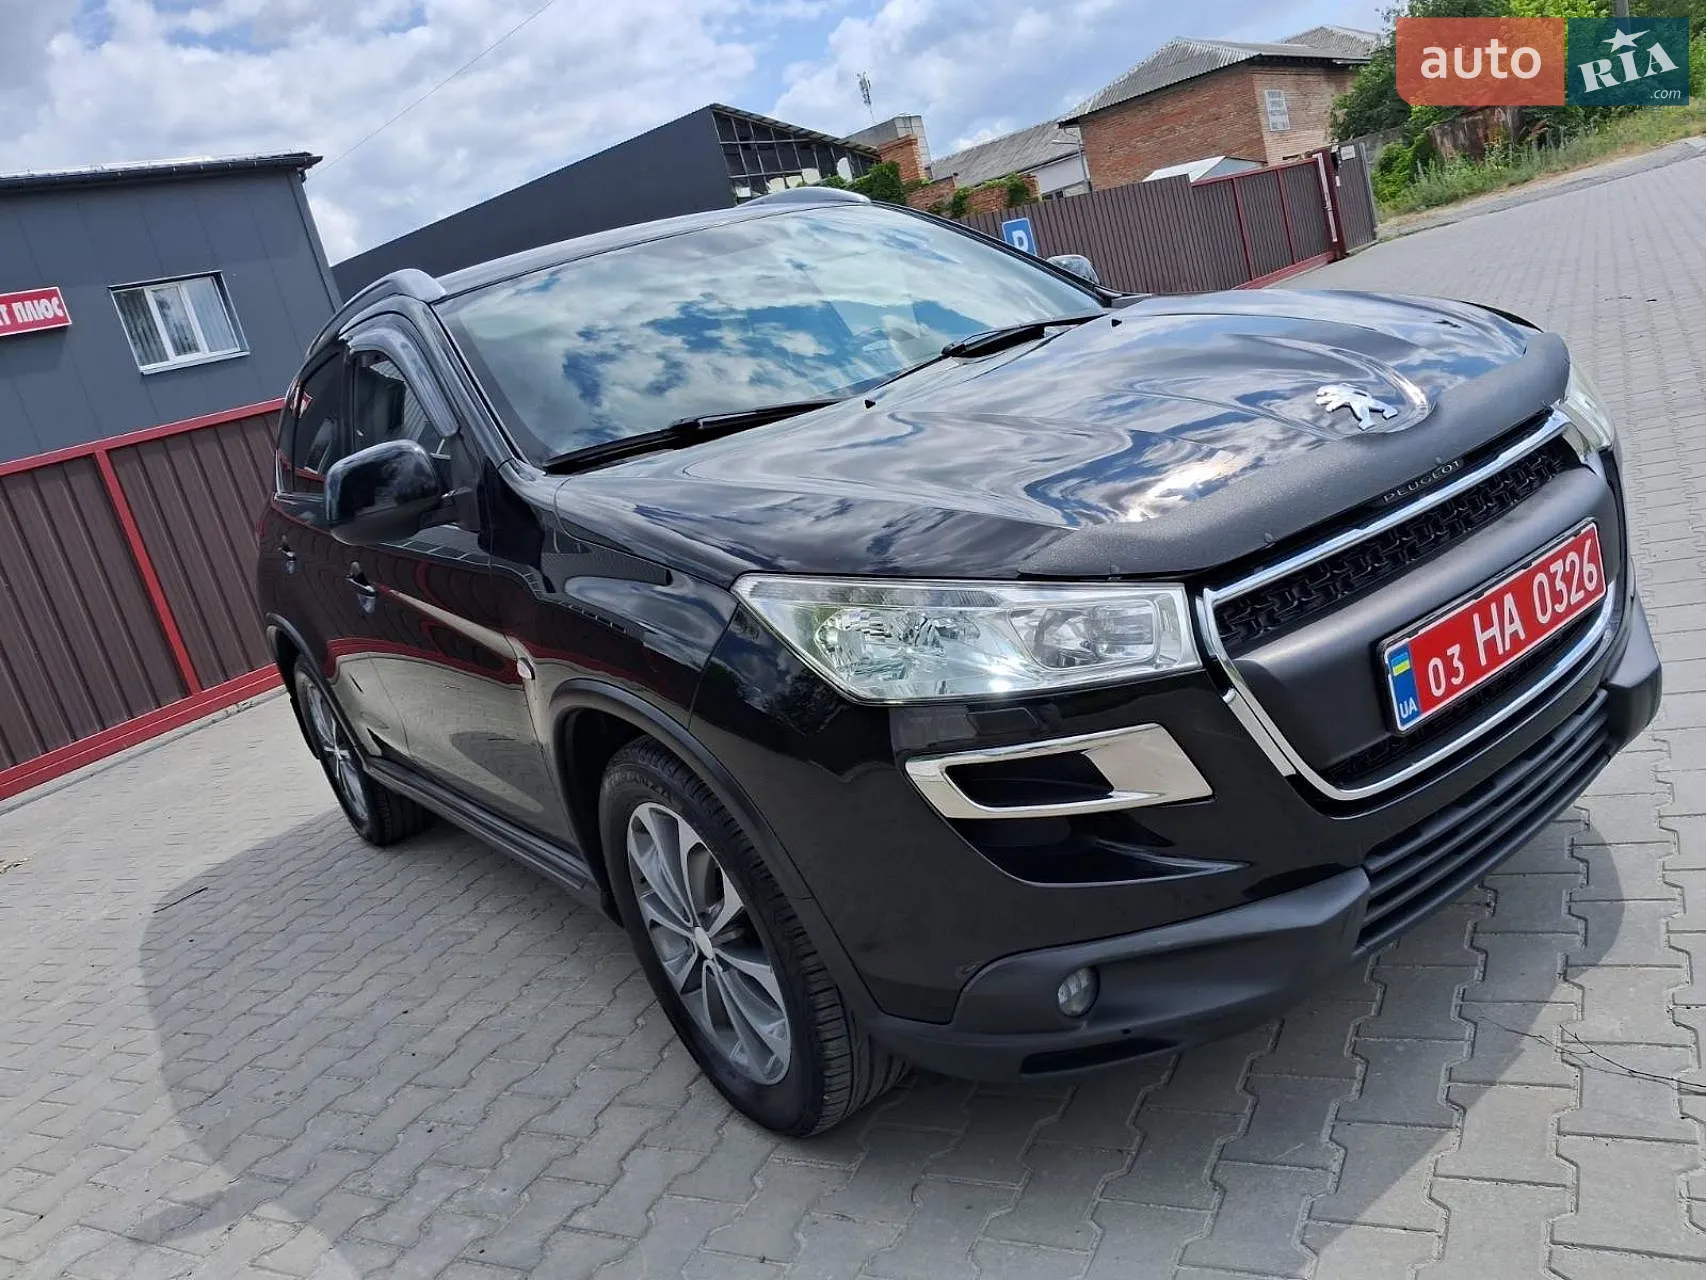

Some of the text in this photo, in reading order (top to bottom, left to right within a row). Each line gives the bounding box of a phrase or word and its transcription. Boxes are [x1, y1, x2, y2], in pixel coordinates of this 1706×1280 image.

[12, 296, 65, 323] ПЛЮС
[1382, 460, 1459, 503] PEUGEOT
[1427, 538, 1599, 698] 03 HA 0326
[1399, 697, 1418, 720] UA
